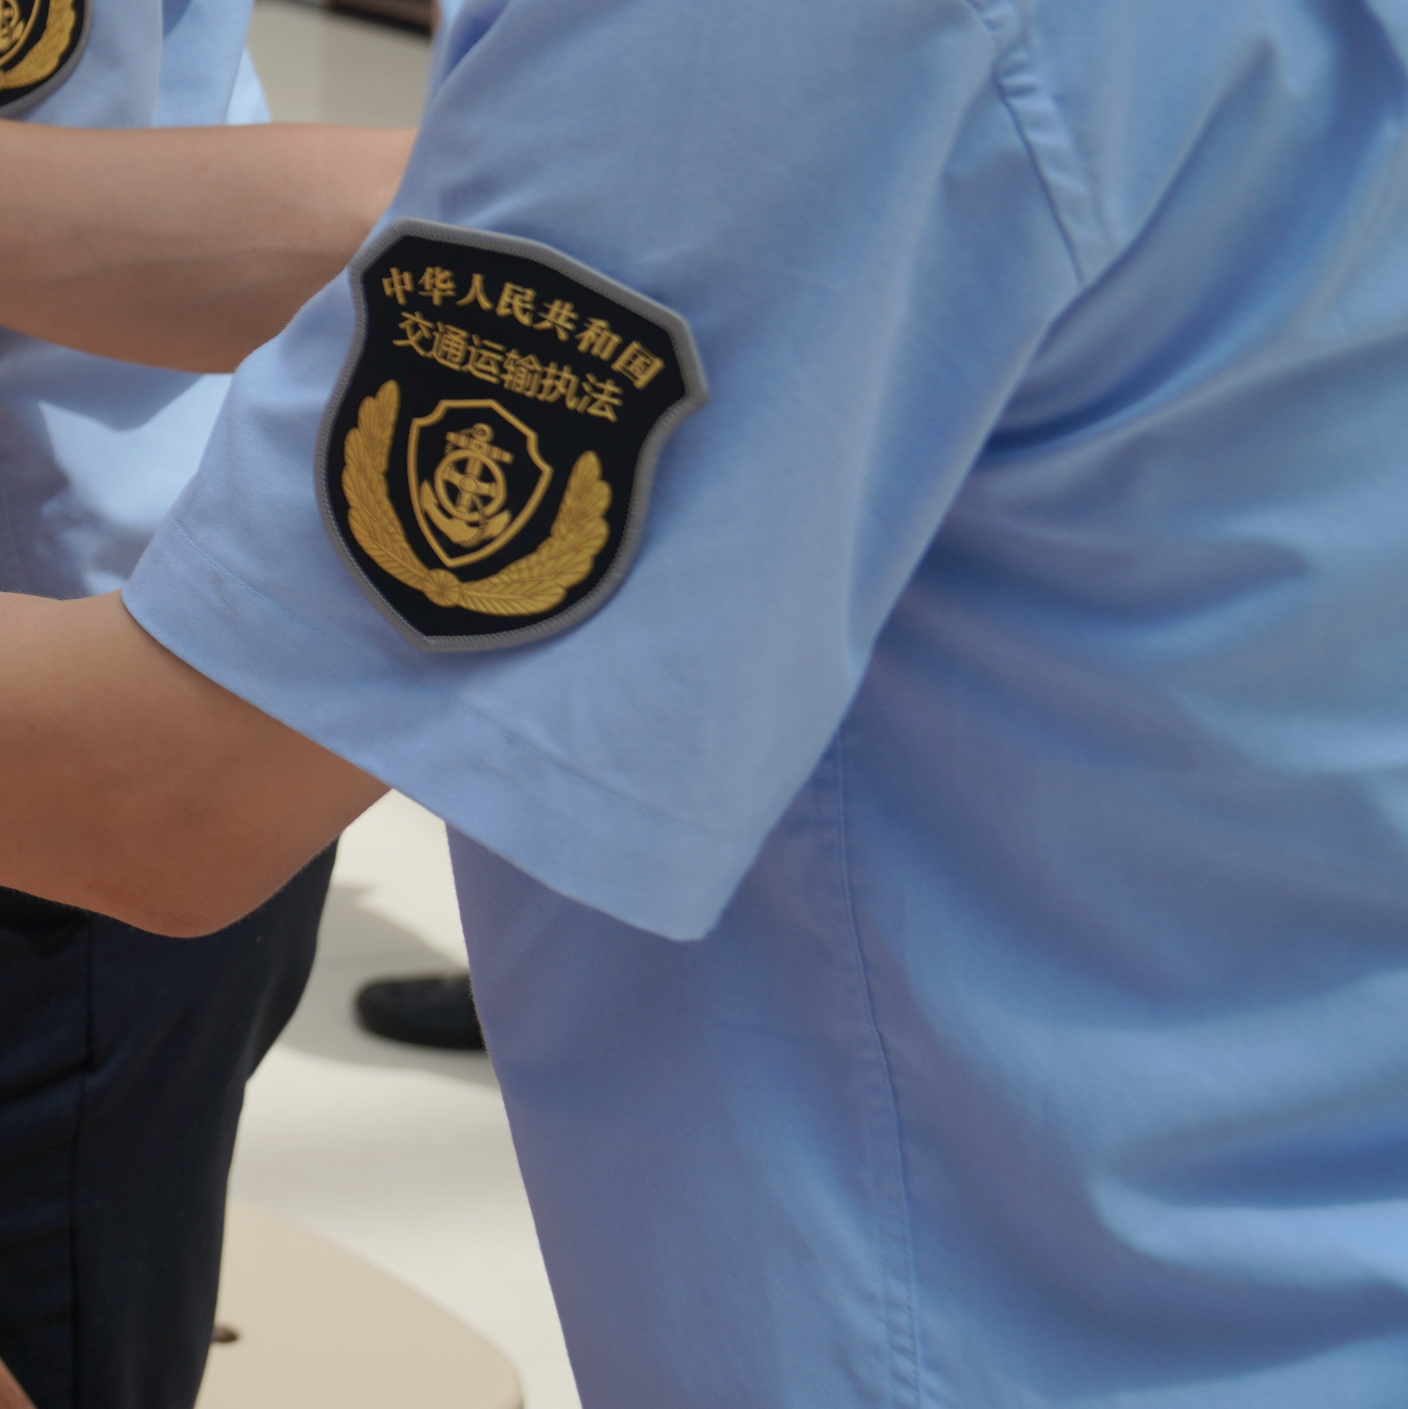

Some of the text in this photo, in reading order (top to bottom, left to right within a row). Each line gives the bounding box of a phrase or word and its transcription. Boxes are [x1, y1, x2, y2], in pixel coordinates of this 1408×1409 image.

[381, 265, 666, 390] 中华人民共和国
[392, 311, 625, 423] 交通运输执法
